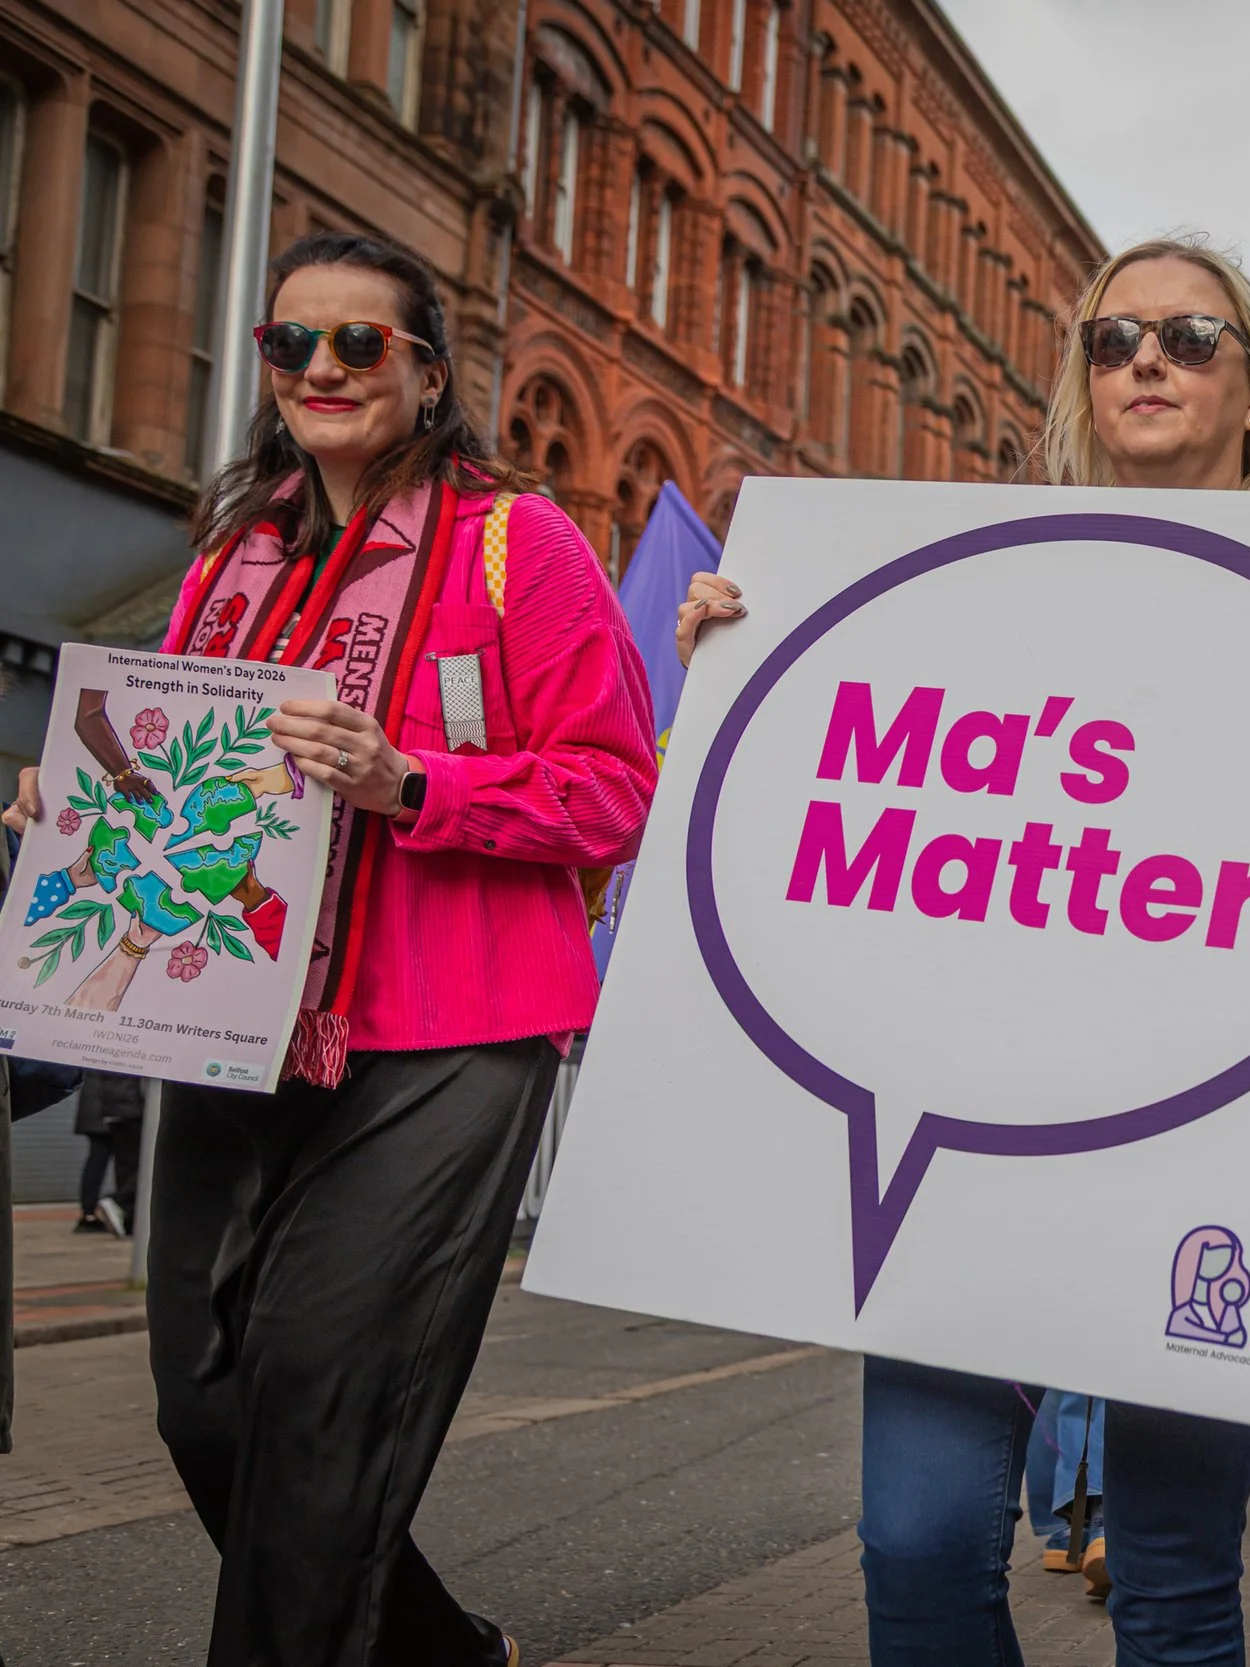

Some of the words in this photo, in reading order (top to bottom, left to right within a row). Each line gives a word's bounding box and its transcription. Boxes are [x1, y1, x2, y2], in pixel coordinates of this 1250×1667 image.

[108, 653, 180, 671] International
[182, 660, 232, 677] Women's
[234, 666, 255, 682] Day
[257, 669, 286, 682] 2026
[338, 612, 390, 712] MENS
[126, 675, 184, 695] Strength
[187, 681, 199, 694] in
[201, 684, 264, 704] Solidarity
[444, 676, 477, 684] PEACE
[815, 681, 1136, 804] Ma's
[0, 1000, 38, 1015] urday
[41, 1004, 61, 1016] 7th
[64, 1007, 105, 1023] March
[119, 1016, 173, 1033] 11.30am
[176, 1022, 221, 1040] Writers
[224, 1027, 268, 1045] Square
[51, 1039, 172, 1064] reclaimtheagenda.com
[228, 1066, 249, 1074] Belfast
[1165, 1341, 1208, 1358] Maternal
